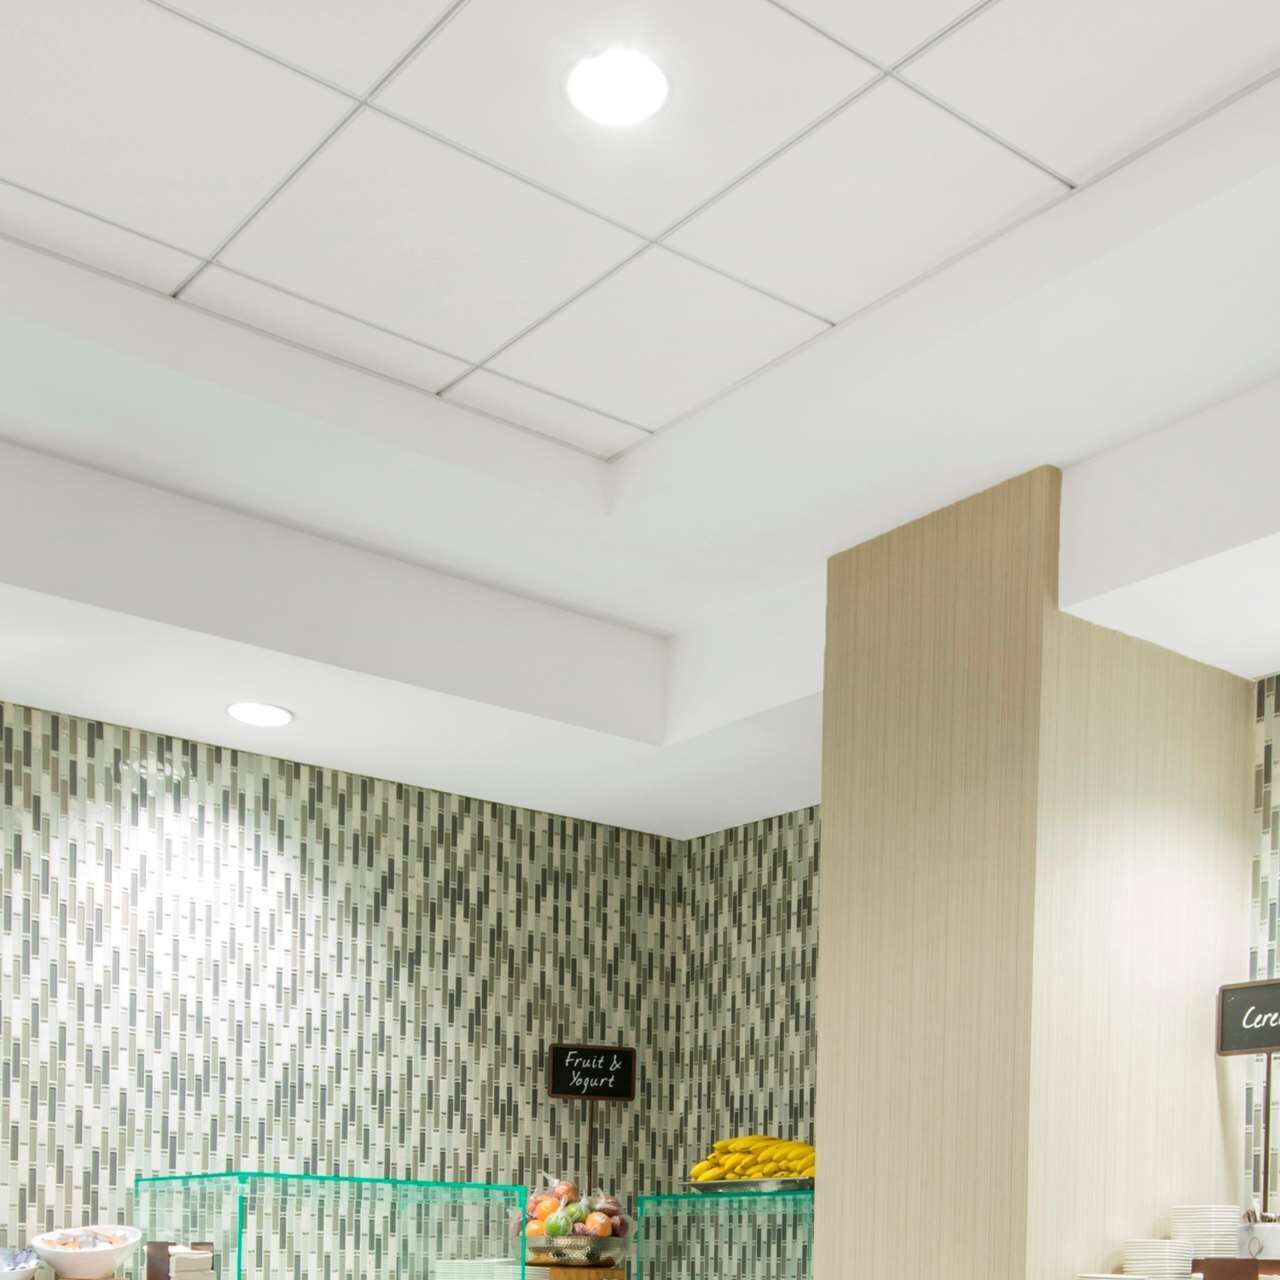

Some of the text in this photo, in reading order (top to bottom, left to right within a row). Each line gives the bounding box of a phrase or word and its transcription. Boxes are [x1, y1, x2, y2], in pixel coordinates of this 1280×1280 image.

[565, 1050, 622, 1071] Fruit &
[569, 1070, 616, 1094] Yogurt
